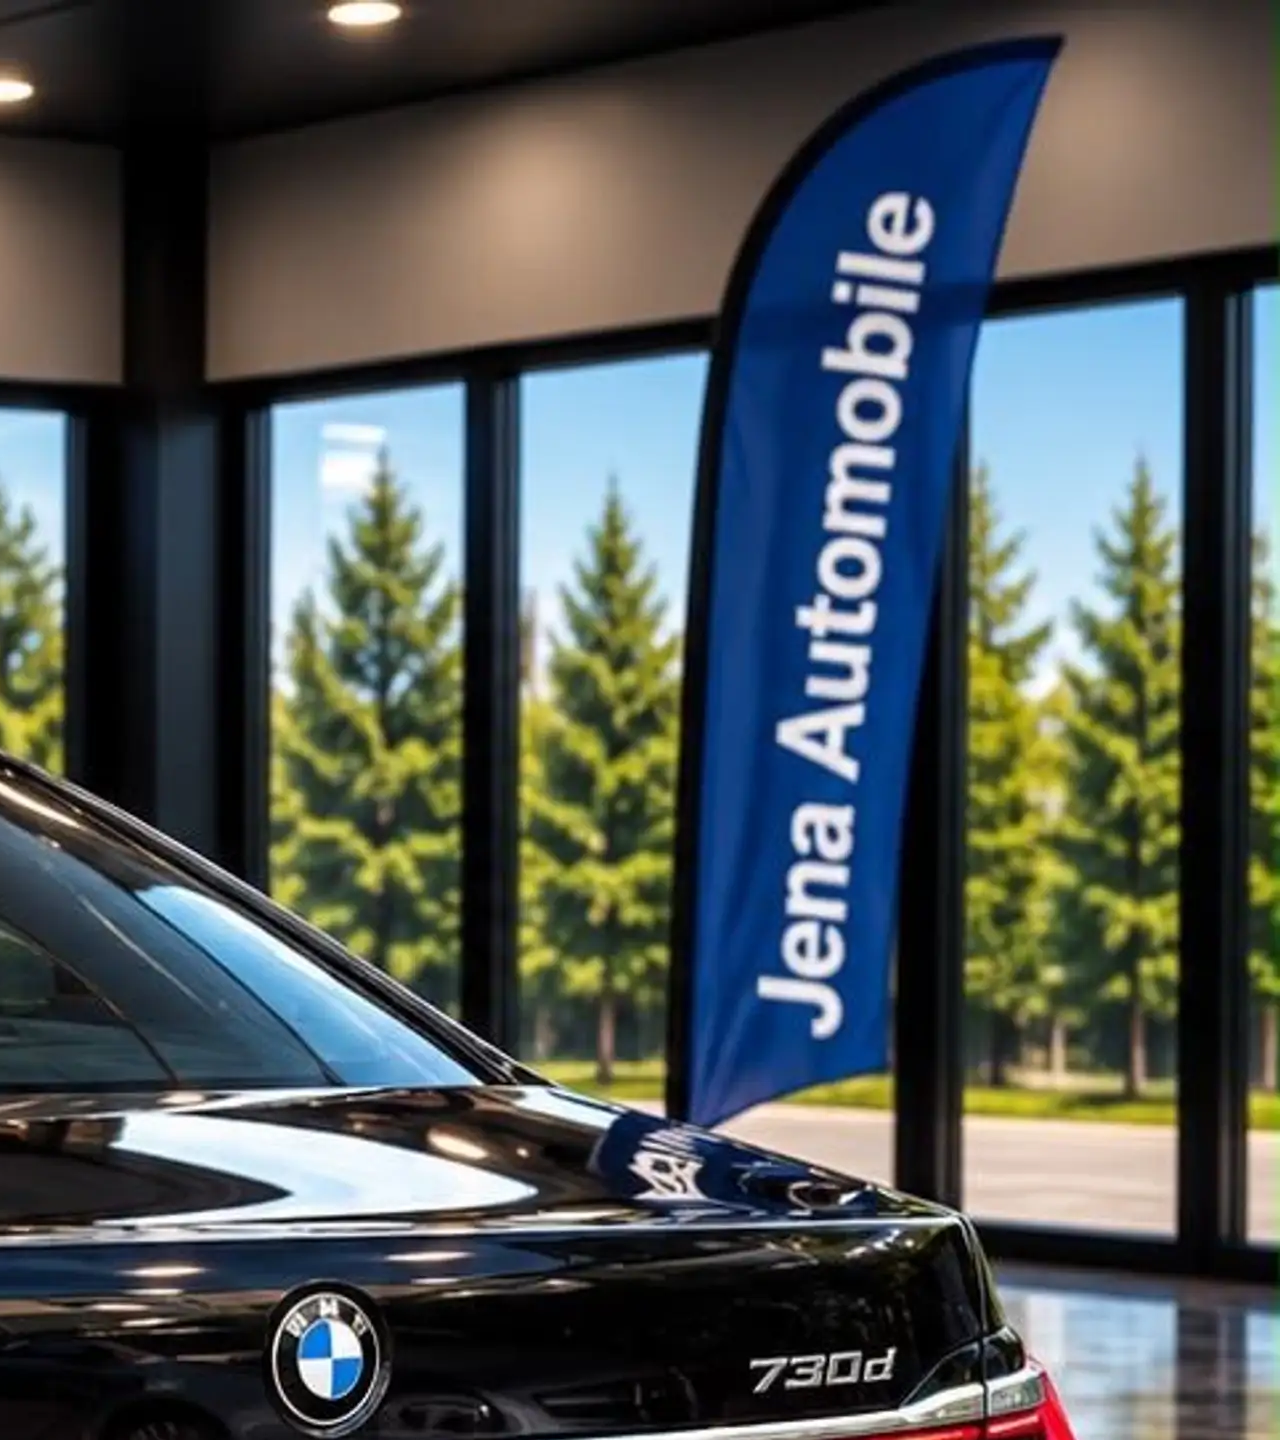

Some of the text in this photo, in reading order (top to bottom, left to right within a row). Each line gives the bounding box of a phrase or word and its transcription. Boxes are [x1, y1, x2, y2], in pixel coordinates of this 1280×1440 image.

[756, 191, 935, 1041] Jena Automobile
[749, 1346, 897, 1394] 730d
